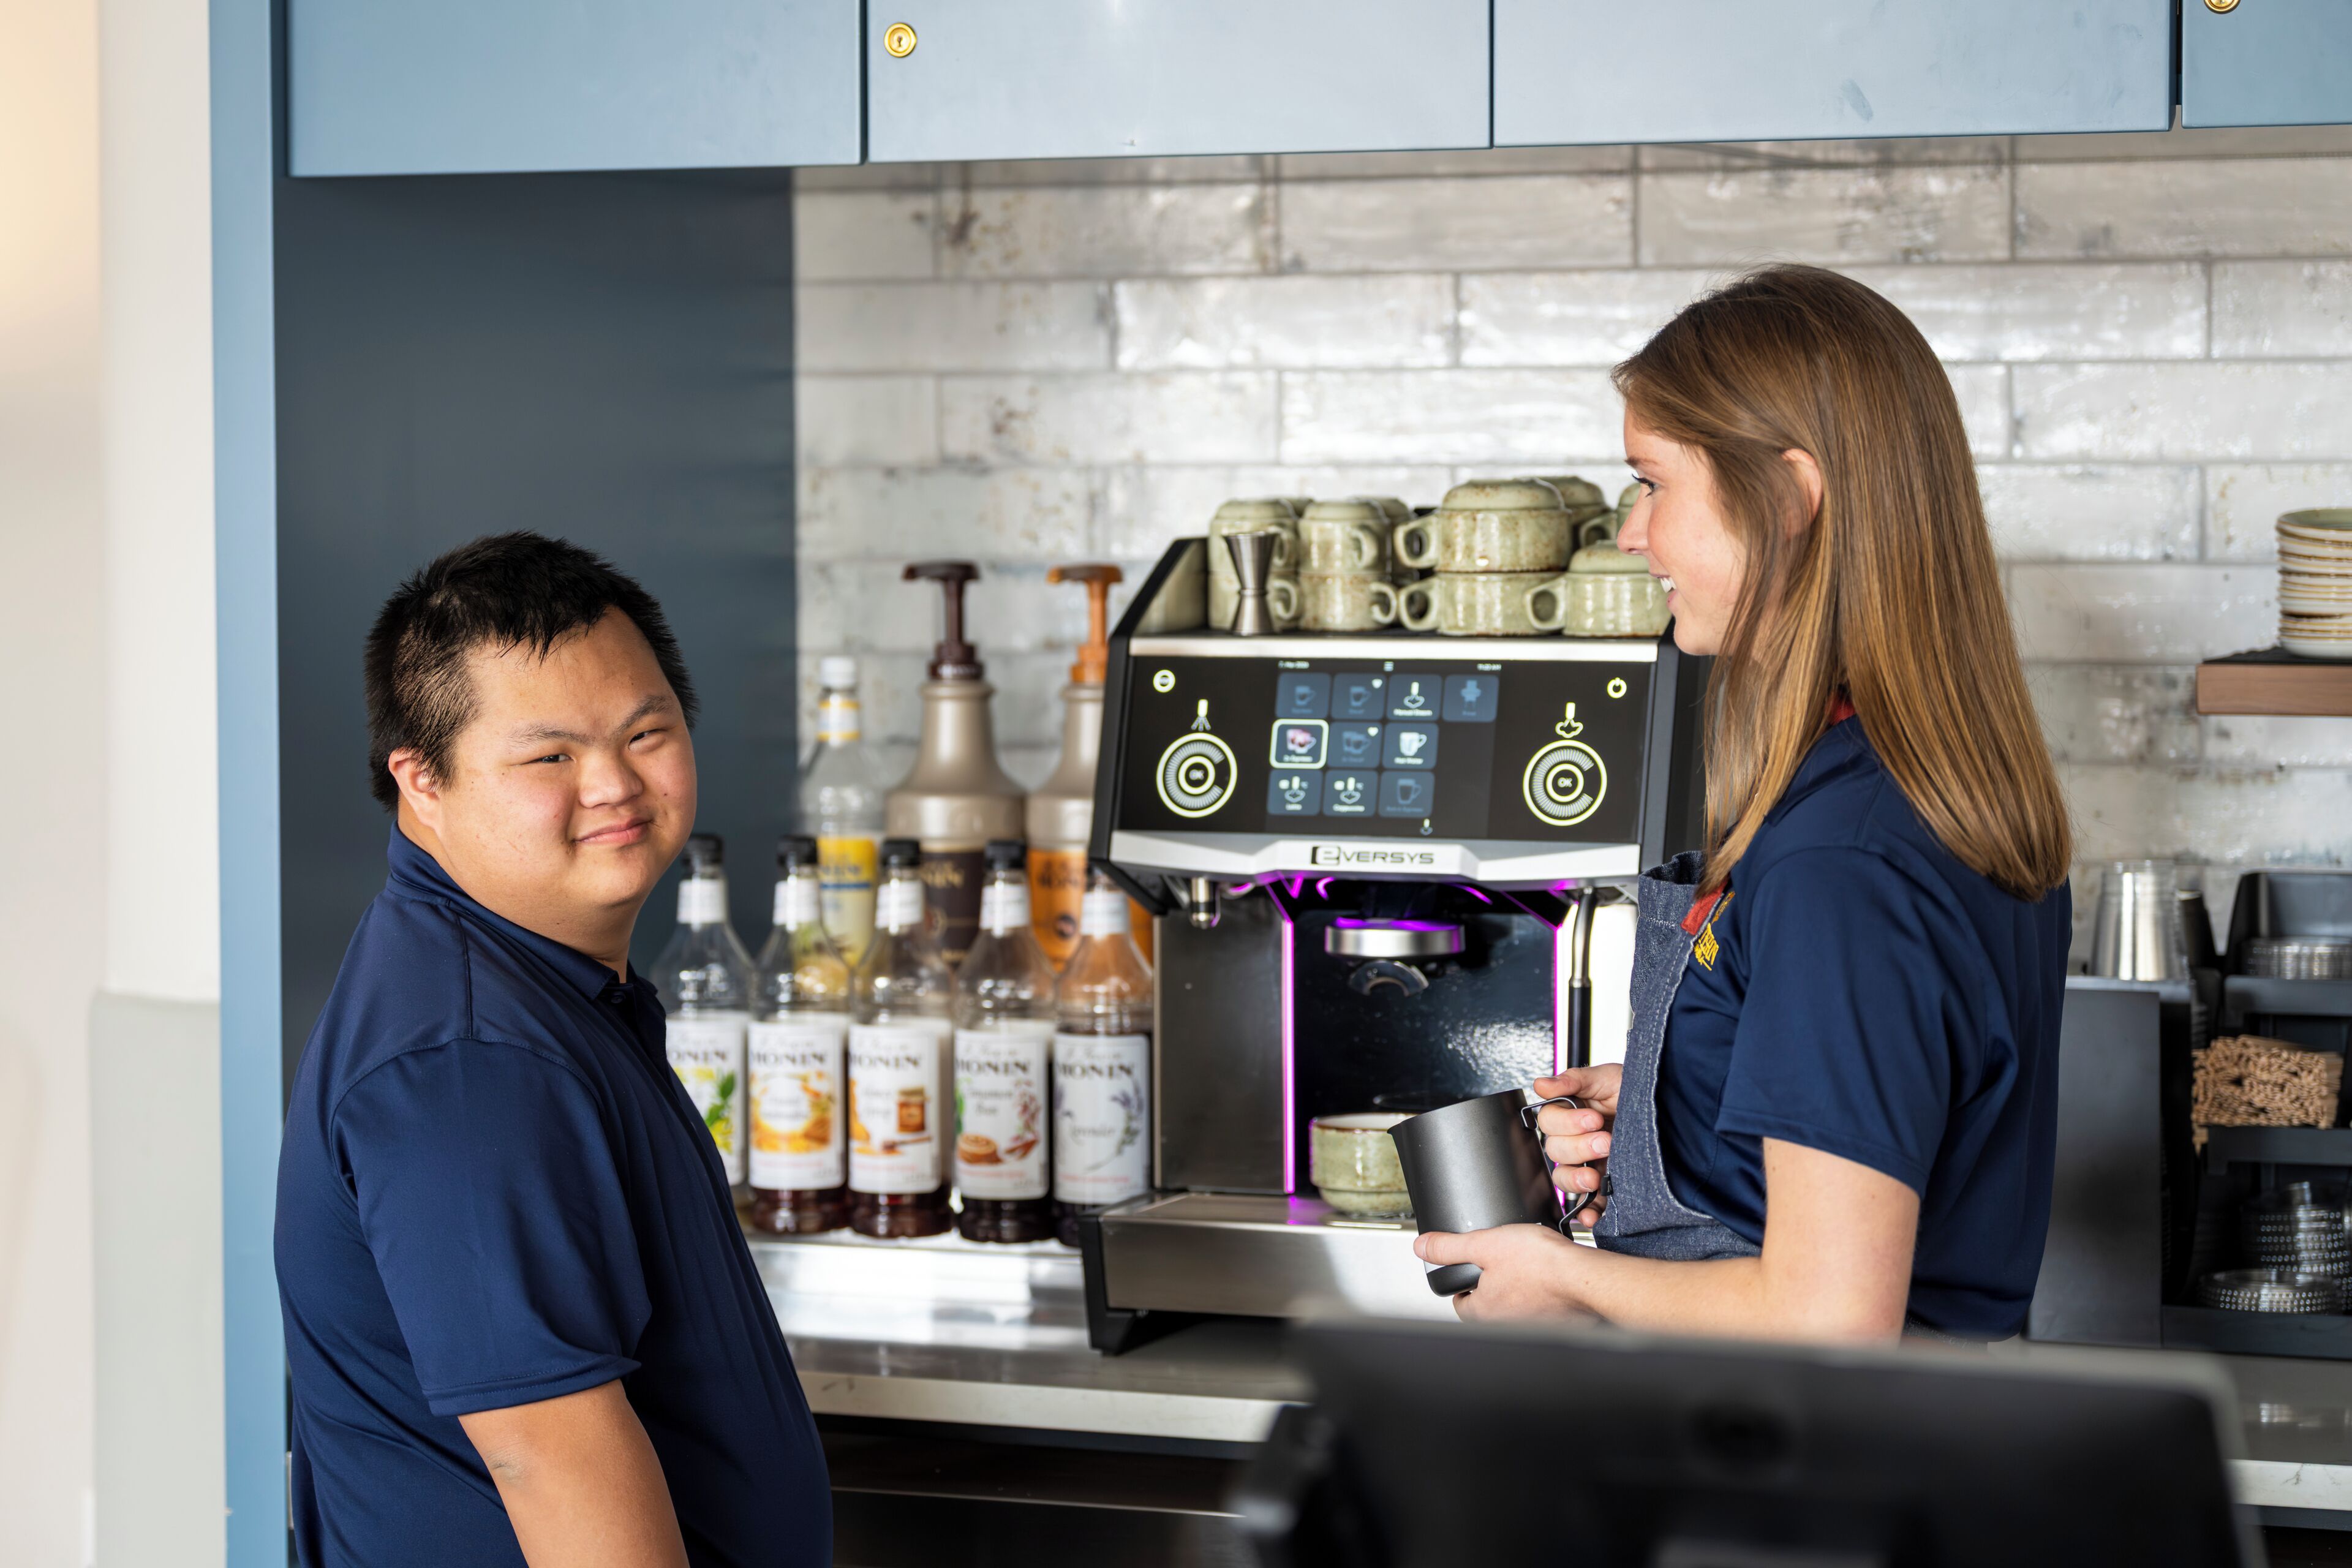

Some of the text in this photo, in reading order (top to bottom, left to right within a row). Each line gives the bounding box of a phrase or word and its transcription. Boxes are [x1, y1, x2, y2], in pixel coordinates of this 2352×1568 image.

[1189, 769, 1205, 781] OK
[1557, 777, 1572, 788] OK
[666, 1049, 727, 1063] ONIN
[752, 1050, 827, 1066] MONIN
[847, 1052, 921, 1069] MONIN
[955, 1058, 1030, 1076] MONIN
[1056, 1063, 1134, 1079] MONIN
